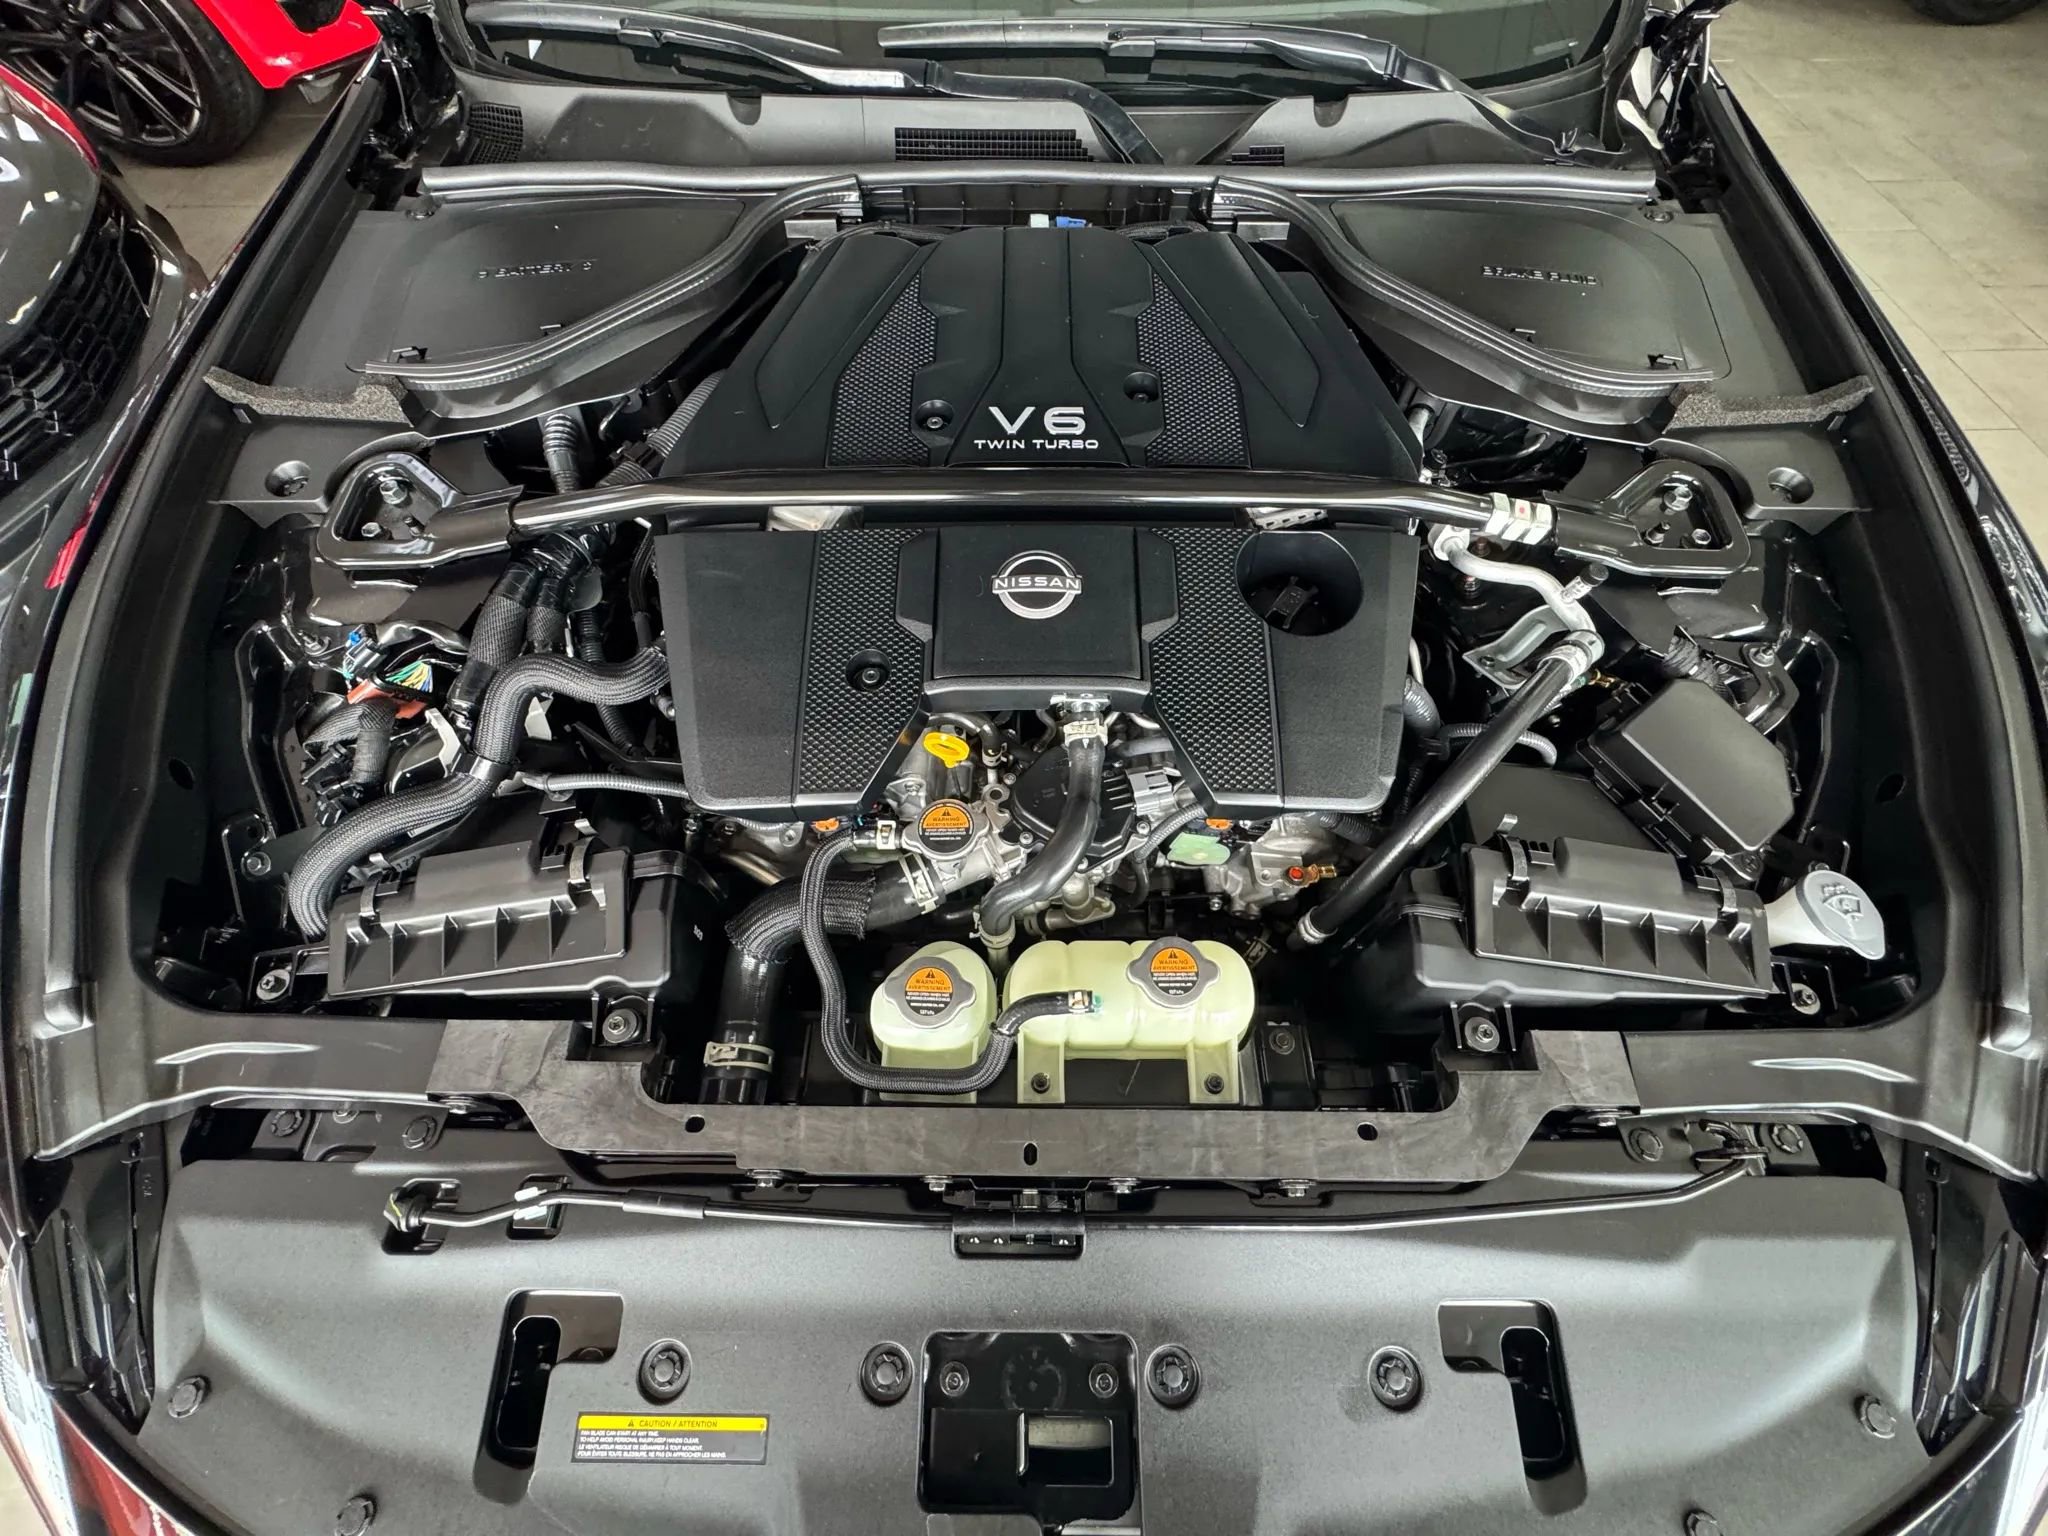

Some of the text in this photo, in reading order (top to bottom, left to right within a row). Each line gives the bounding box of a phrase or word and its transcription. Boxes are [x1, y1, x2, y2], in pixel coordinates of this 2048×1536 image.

[1483, 266, 1597, 285] BRAKE FLUID
[988, 406, 1086, 435] V6
[974, 439, 1099, 450] TWIN TURBO
[994, 576, 1080, 589] NISSAN
[639, 1419, 671, 1428] CAUTION
[678, 1420, 718, 1428] ATTENTION
